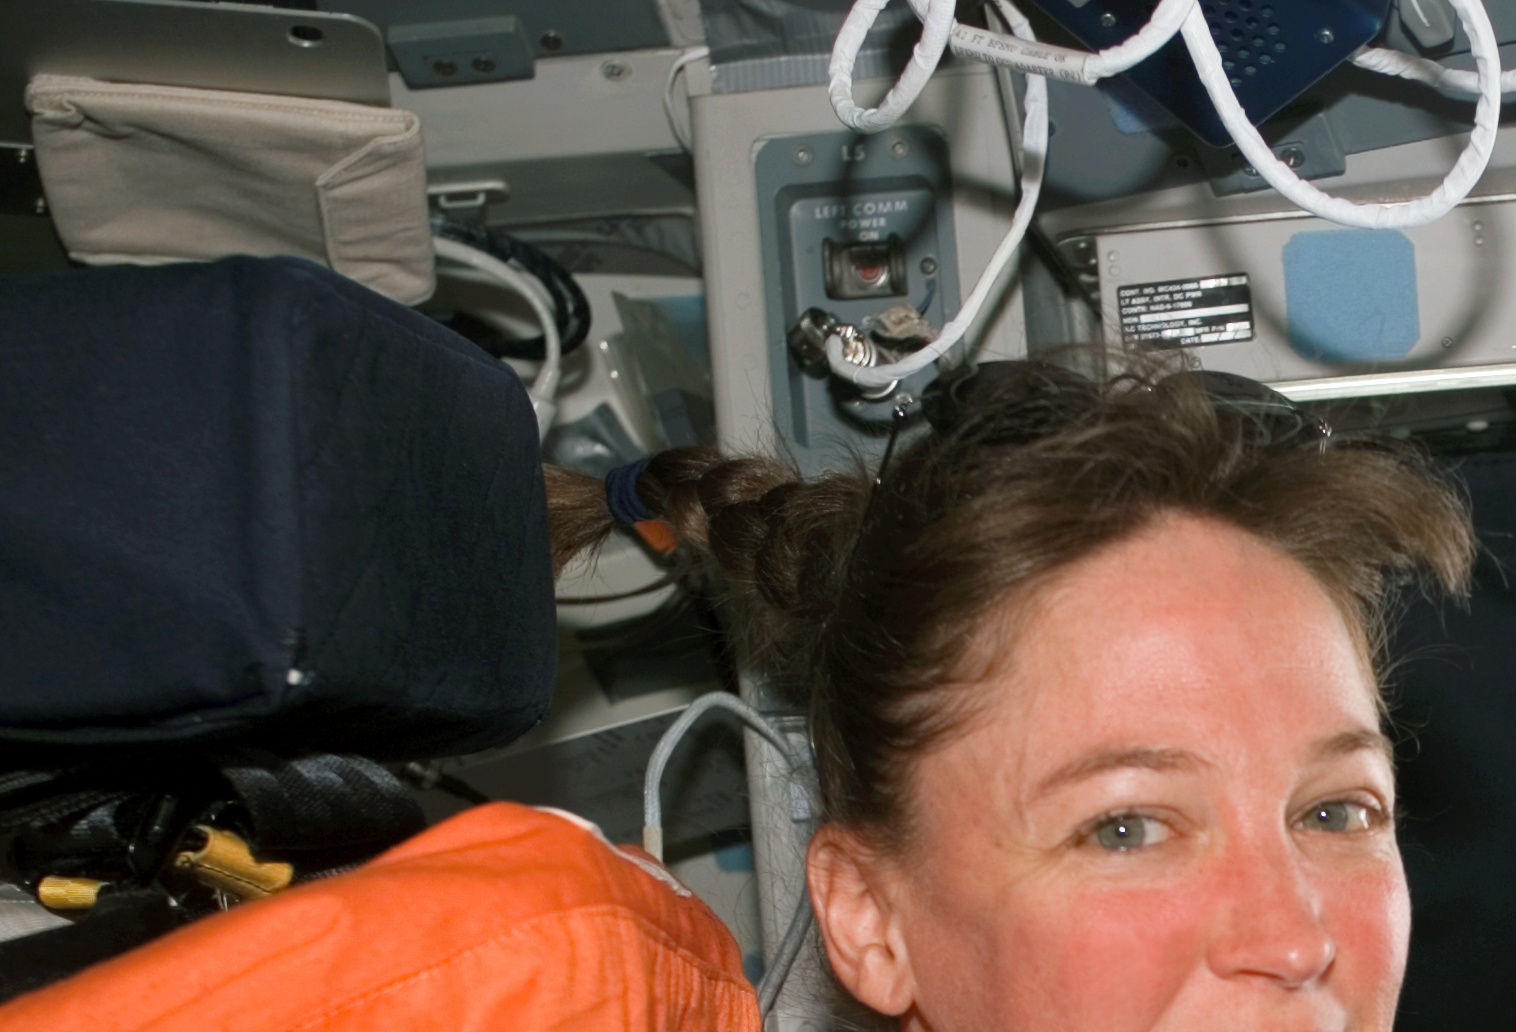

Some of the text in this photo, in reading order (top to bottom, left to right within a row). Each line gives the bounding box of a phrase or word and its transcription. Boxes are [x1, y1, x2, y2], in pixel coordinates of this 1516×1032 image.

[853, 200, 907, 216] COMM
[840, 217, 886, 229] POWER
[859, 231, 880, 241] ON
